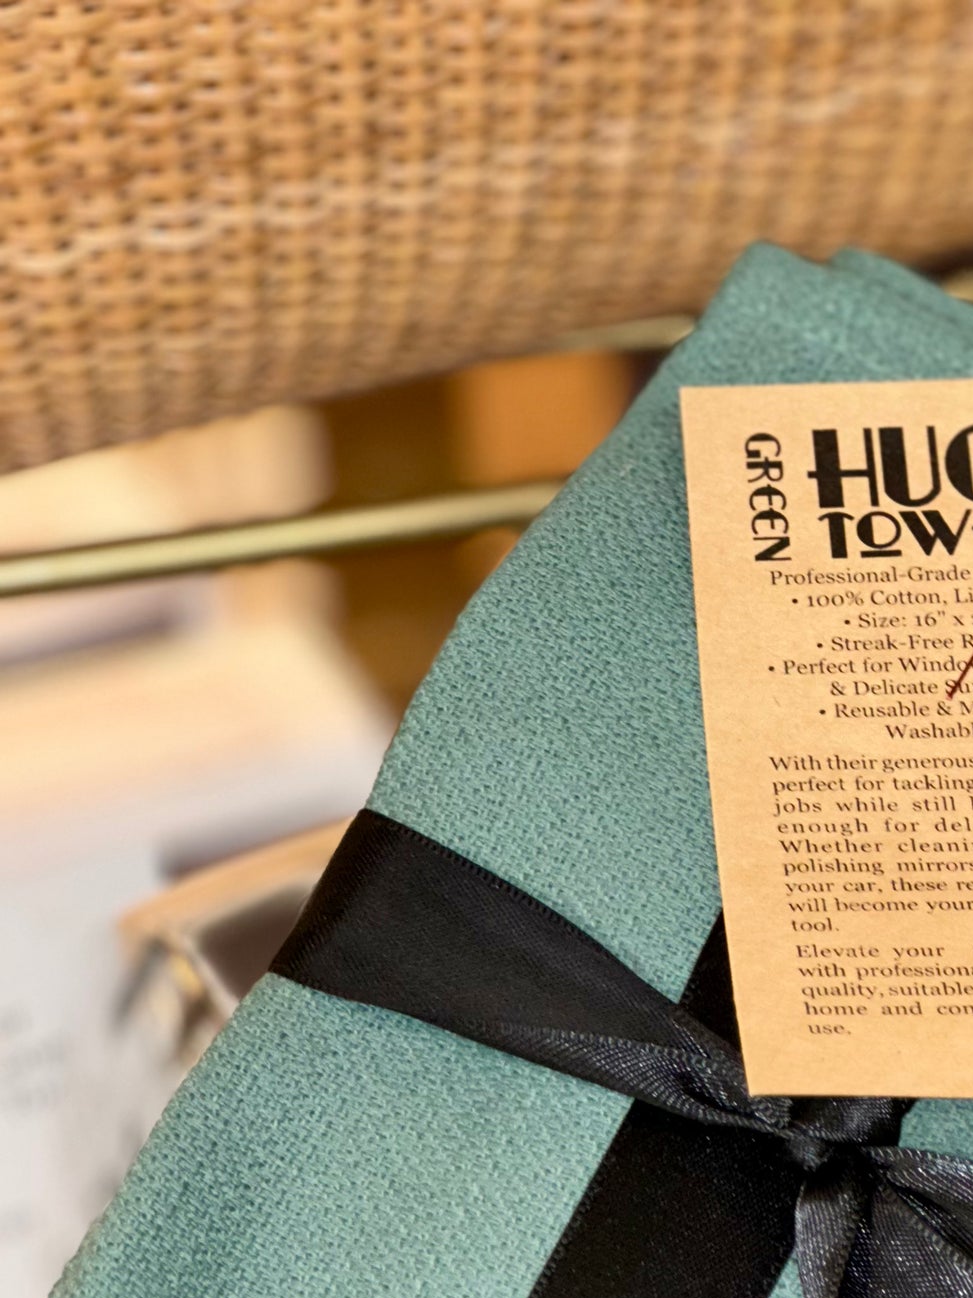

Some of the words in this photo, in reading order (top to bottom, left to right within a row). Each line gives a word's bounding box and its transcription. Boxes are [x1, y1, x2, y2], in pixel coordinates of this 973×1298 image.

[745, 432, 791, 561] GREEN
[770, 566, 971, 585] Professional-Grade
[807, 591, 864, 608] 100%
[870, 589, 948, 606] Cotton,
[858, 613, 907, 628] Size:
[915, 610, 945, 626] 16"
[953, 614, 964, 625] x
[831, 636, 954, 651] Streak-Free
[783, 659, 855, 675] Perfect
[863, 657, 892, 673] for
[830, 681, 846, 696] &
[853, 680, 938, 695] Delicate
[835, 702, 930, 718] Reusable
[936, 701, 951, 716] &
[769, 755, 822, 771] With
[827, 755, 878, 771] their
[772, 776, 846, 795] perfect
[855, 776, 884, 791] for
[774, 798, 822, 816] jobs
[836, 797, 899, 812] while
[912, 796, 956, 812] still
[777, 818, 868, 836] enough
[884, 818, 920, 833] for
[778, 839, 884, 853] Whether
[783, 858, 885, 876] polishing
[786, 881, 834, 896] your
[843, 879, 883, 893] car,
[891, 878, 948, 891] these
[789, 899, 827, 913] will
[835, 898, 918, 913] become
[791, 918, 840, 932] tool.
[795, 944, 880, 959] Elevate
[893, 945, 945, 962] your
[799, 963, 847, 978] with
[801, 983, 885, 1000] quality,
[804, 1002, 867, 1017] home
[882, 1001, 923, 1015] and
